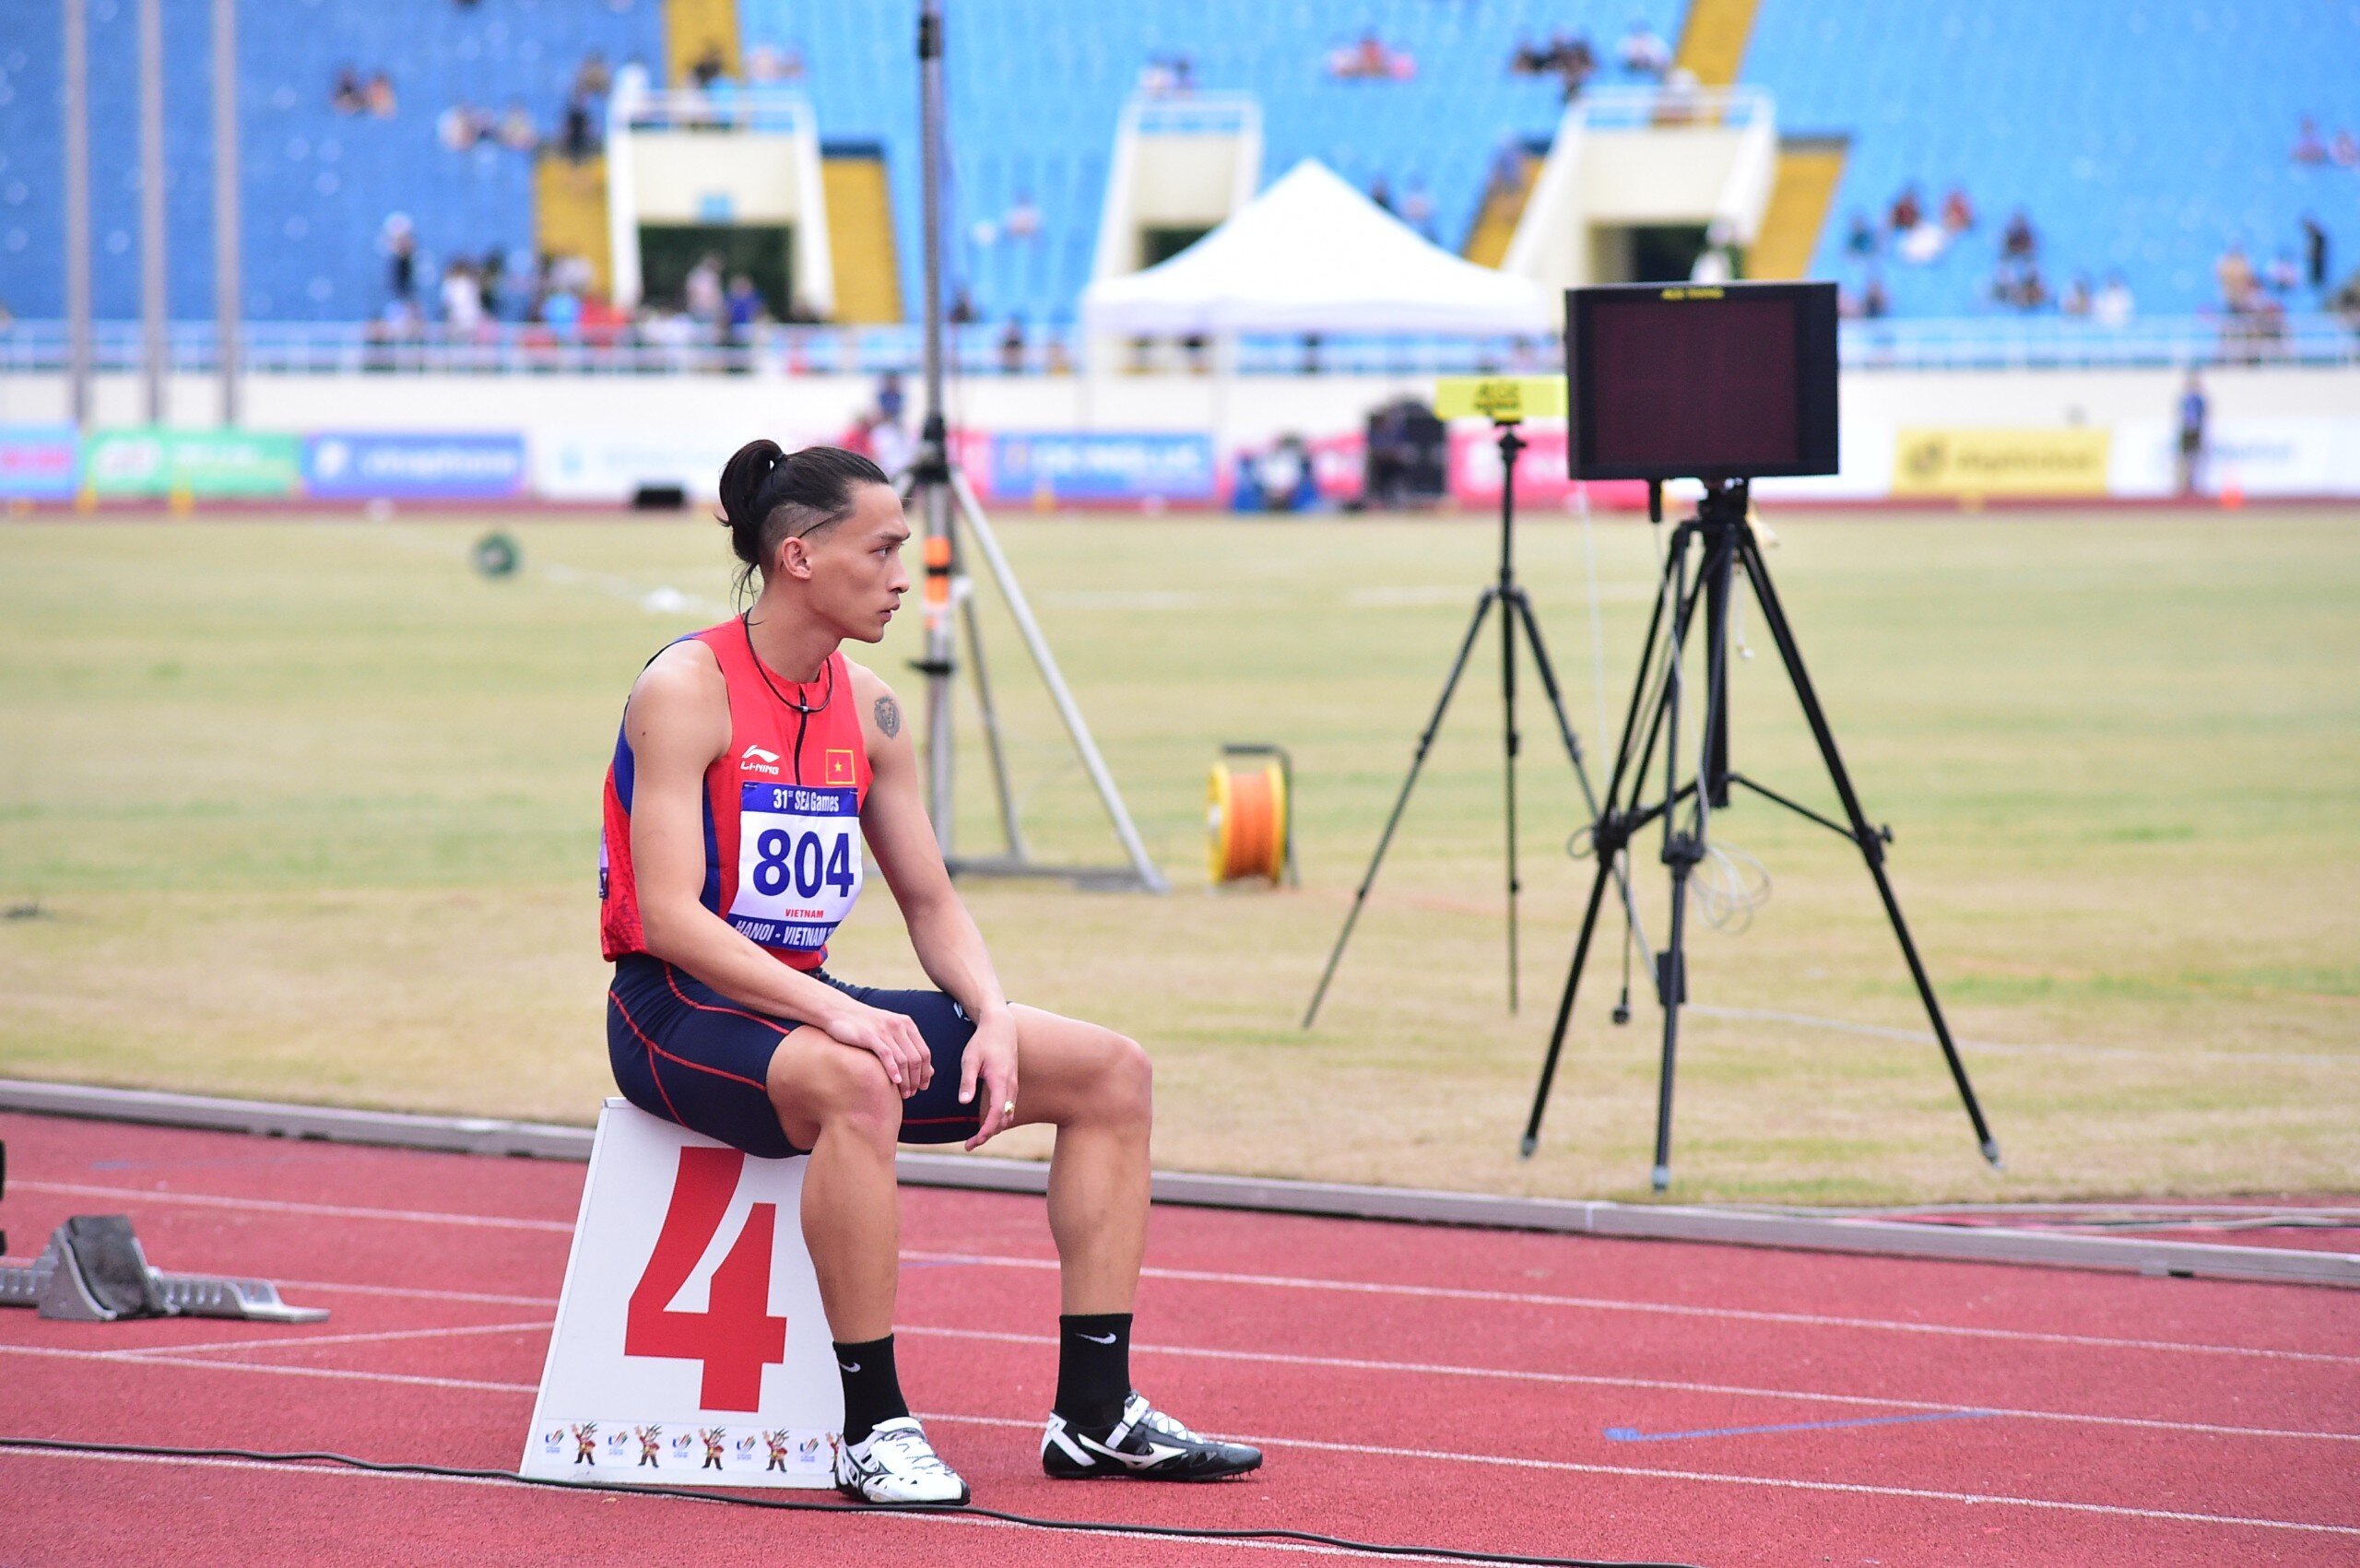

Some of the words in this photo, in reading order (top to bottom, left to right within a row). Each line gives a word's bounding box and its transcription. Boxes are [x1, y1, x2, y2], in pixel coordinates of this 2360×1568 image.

[740, 761, 779, 774] LI-NING
[795, 790, 810, 811] SEA
[810, 792, 840, 812] Games
[753, 828, 854, 898] 804
[785, 908, 824, 918] VIETNAM
[735, 920, 775, 941] HANOI
[782, 925, 827, 947] VIETNAM
[624, 1146, 787, 1413] 4
